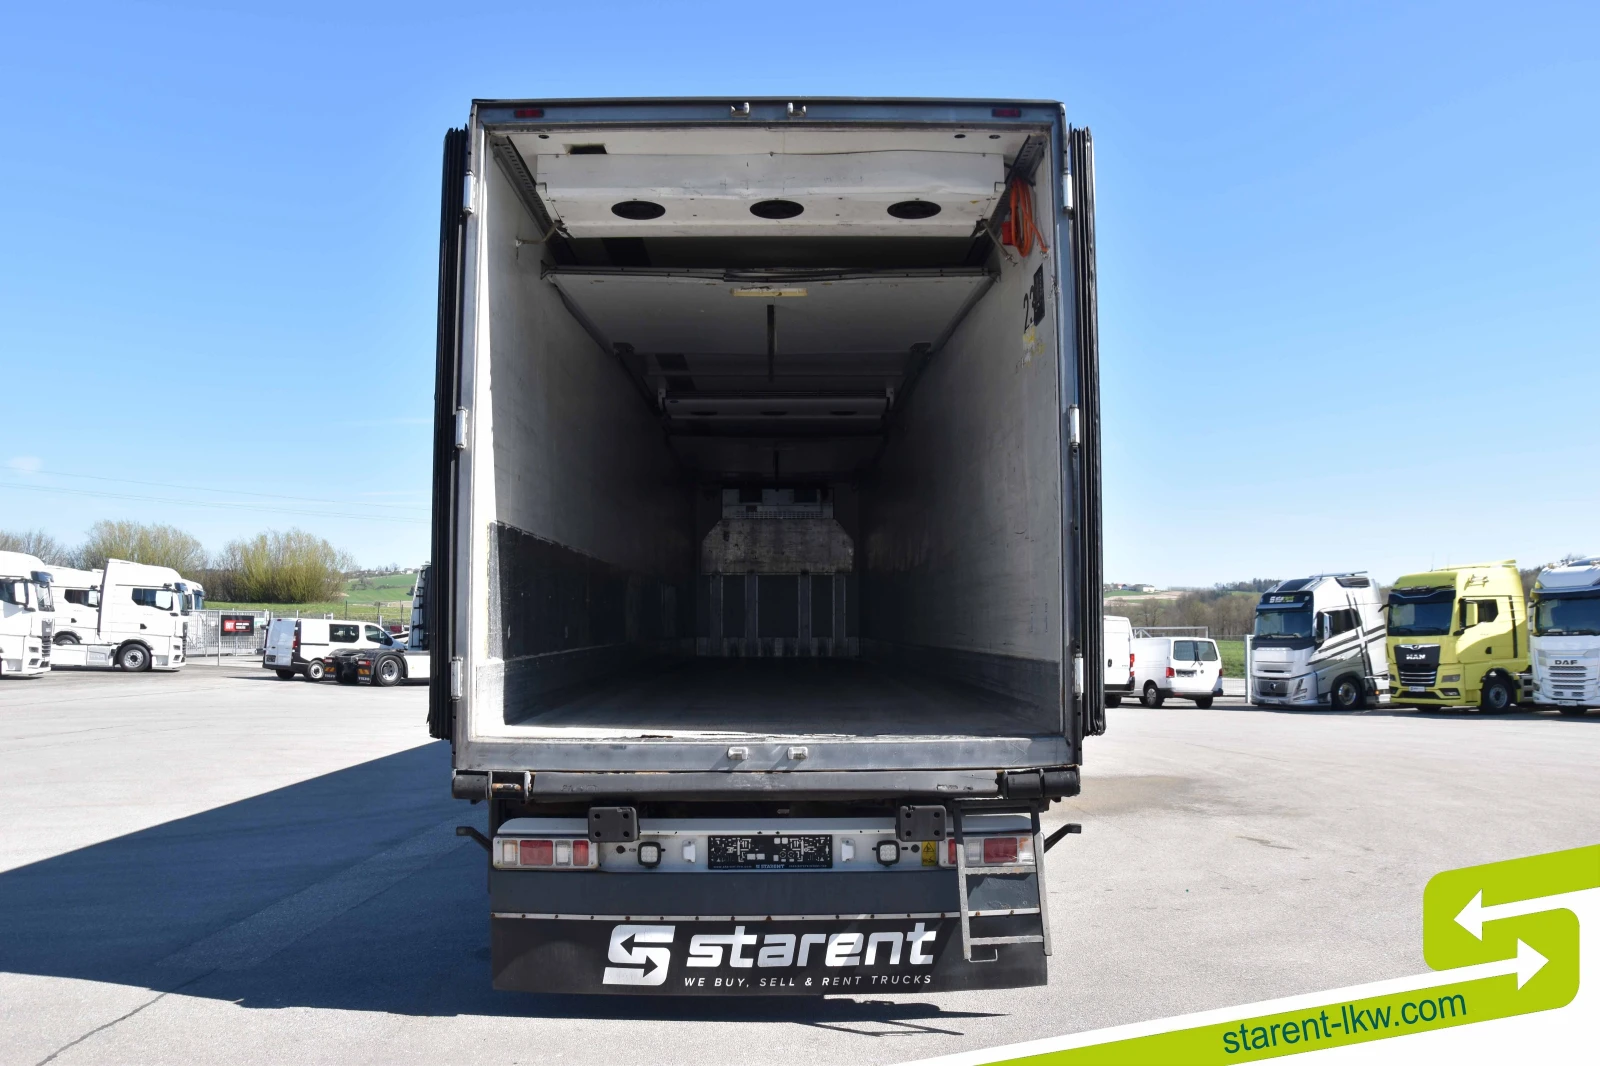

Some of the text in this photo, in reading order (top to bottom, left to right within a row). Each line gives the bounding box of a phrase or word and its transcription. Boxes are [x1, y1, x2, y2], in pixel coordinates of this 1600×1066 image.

[686, 923, 937, 968] starent
[684, 974, 932, 988] WE BUY, SELL & RENT TRUCKS
